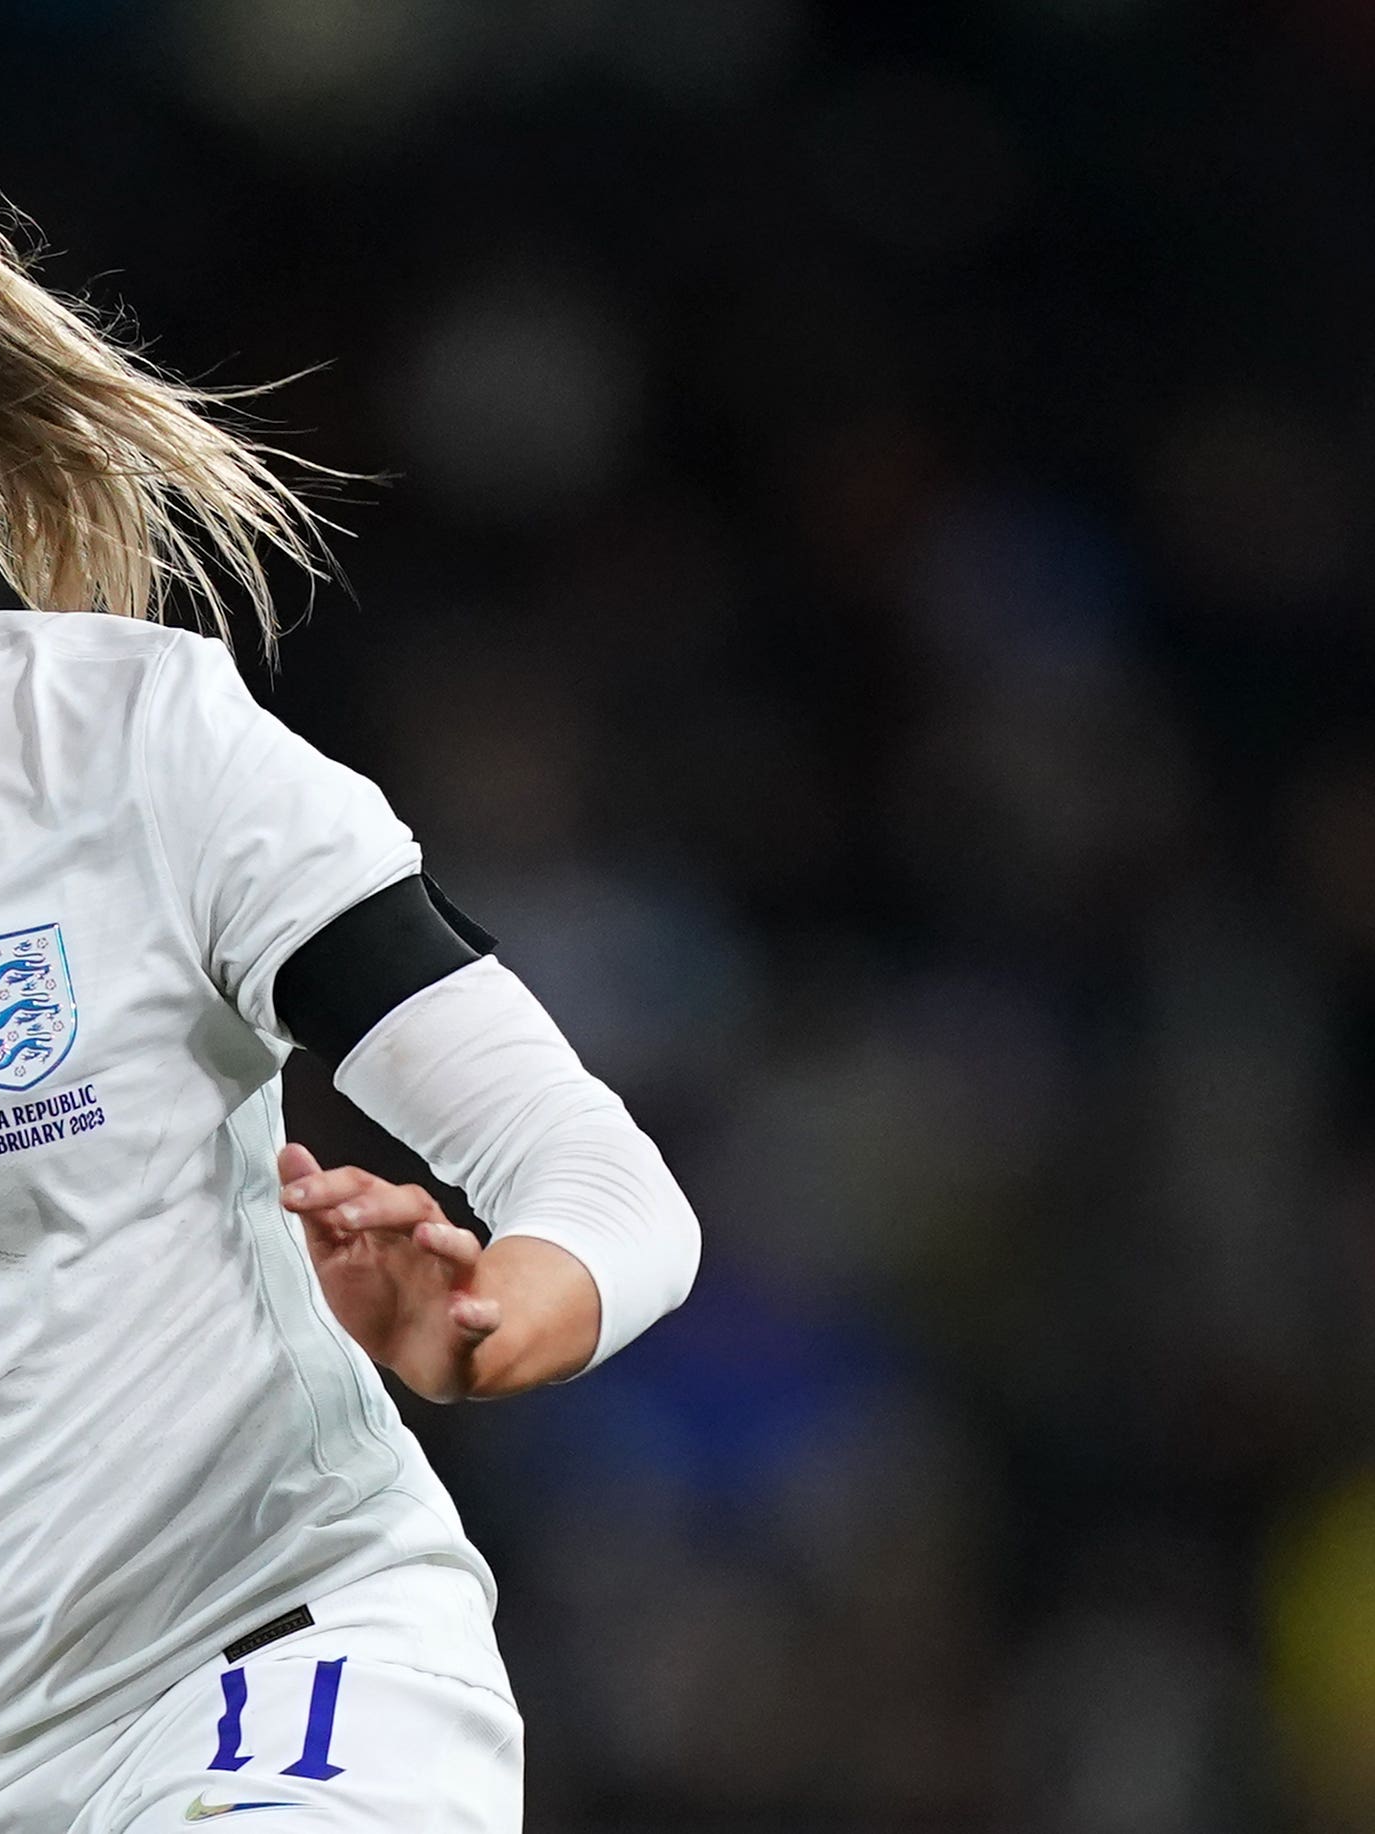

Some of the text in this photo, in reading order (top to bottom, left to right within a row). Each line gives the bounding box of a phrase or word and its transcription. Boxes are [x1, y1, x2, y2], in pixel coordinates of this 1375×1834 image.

[12, 1084, 97, 1126] REPUBLIC
[69, 1107, 105, 1136] 2023
[206, 1655, 348, 1782] 11
